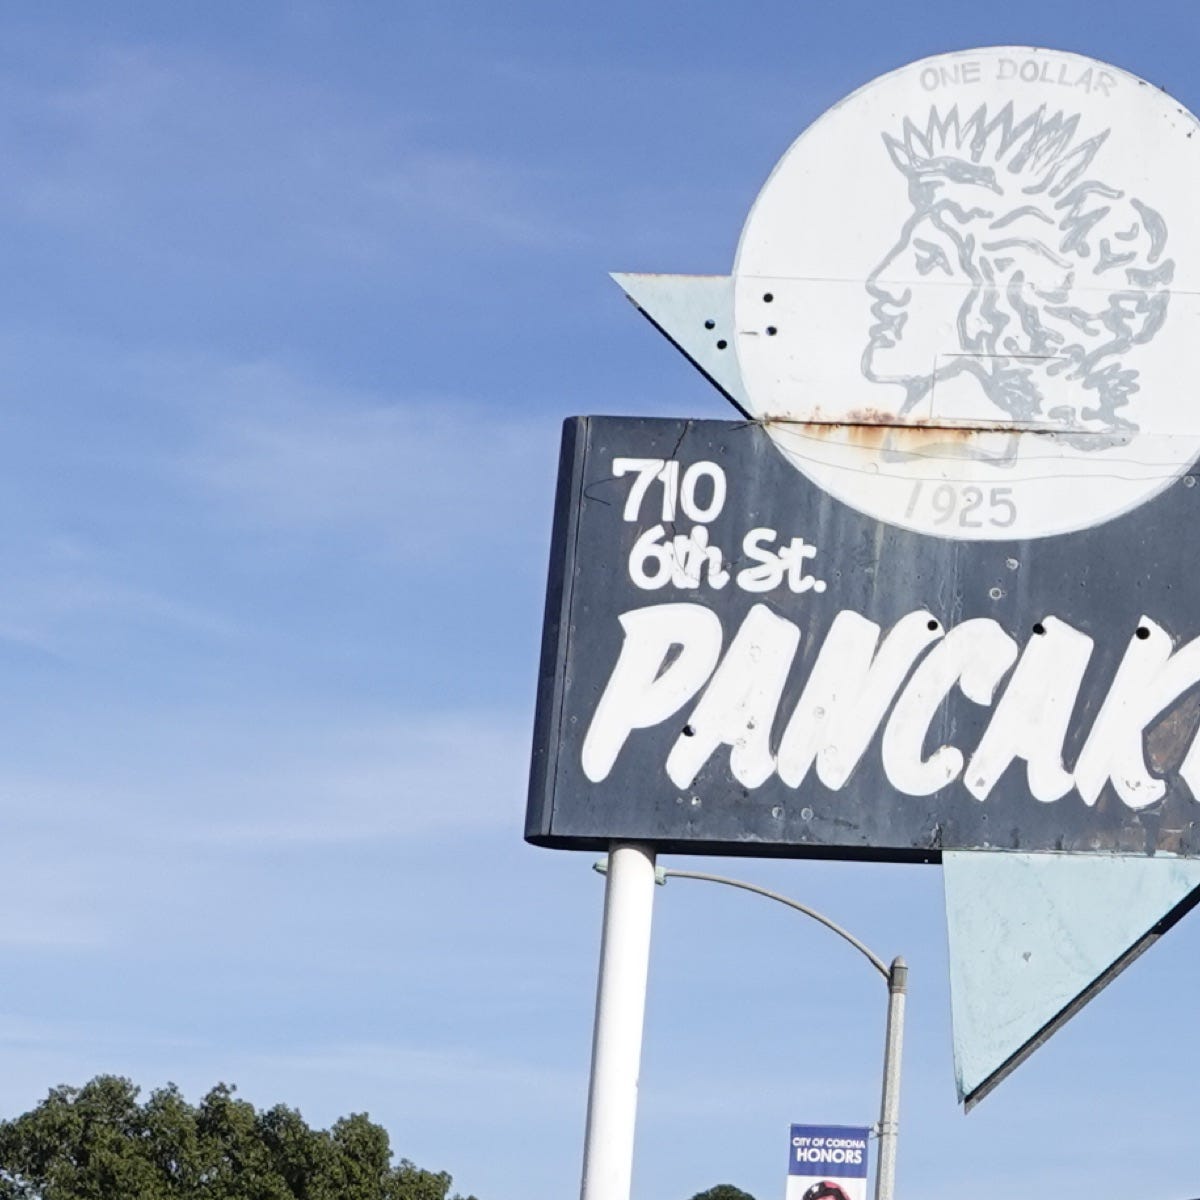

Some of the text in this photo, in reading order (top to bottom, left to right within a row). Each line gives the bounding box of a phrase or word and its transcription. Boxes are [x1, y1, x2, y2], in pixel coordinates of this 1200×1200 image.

[919, 58, 1118, 97] ONE DOLLAR
[612, 458, 727, 523] 710
[904, 482, 1017, 529] 1925
[628, 524, 827, 593] 6th St.
[792, 1136, 866, 1149] CITY OF CORONA
[797, 1148, 863, 1164] HONORS
